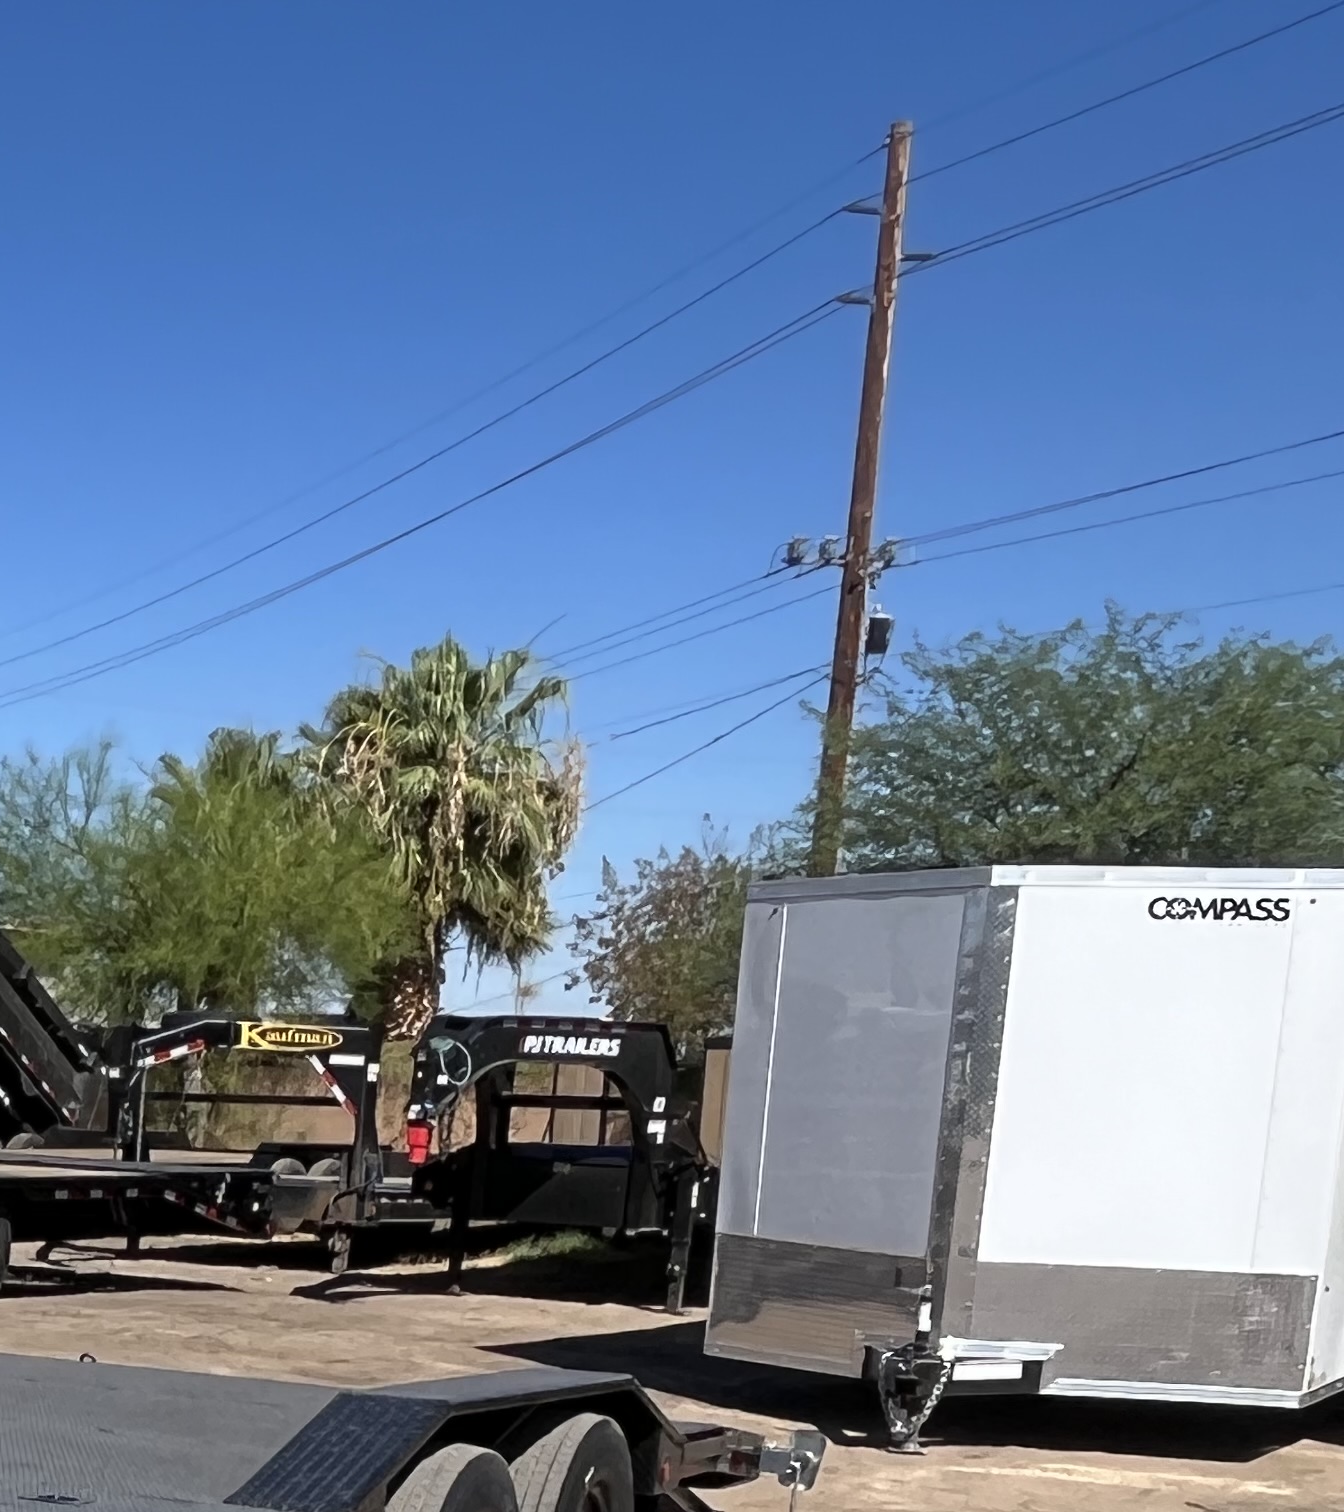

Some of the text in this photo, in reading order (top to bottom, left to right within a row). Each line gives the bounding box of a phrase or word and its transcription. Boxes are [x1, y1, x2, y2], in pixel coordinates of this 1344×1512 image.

[1148, 896, 1291, 922] COMPASS
[523, 1034, 622, 1057] PJ TRAILERS
